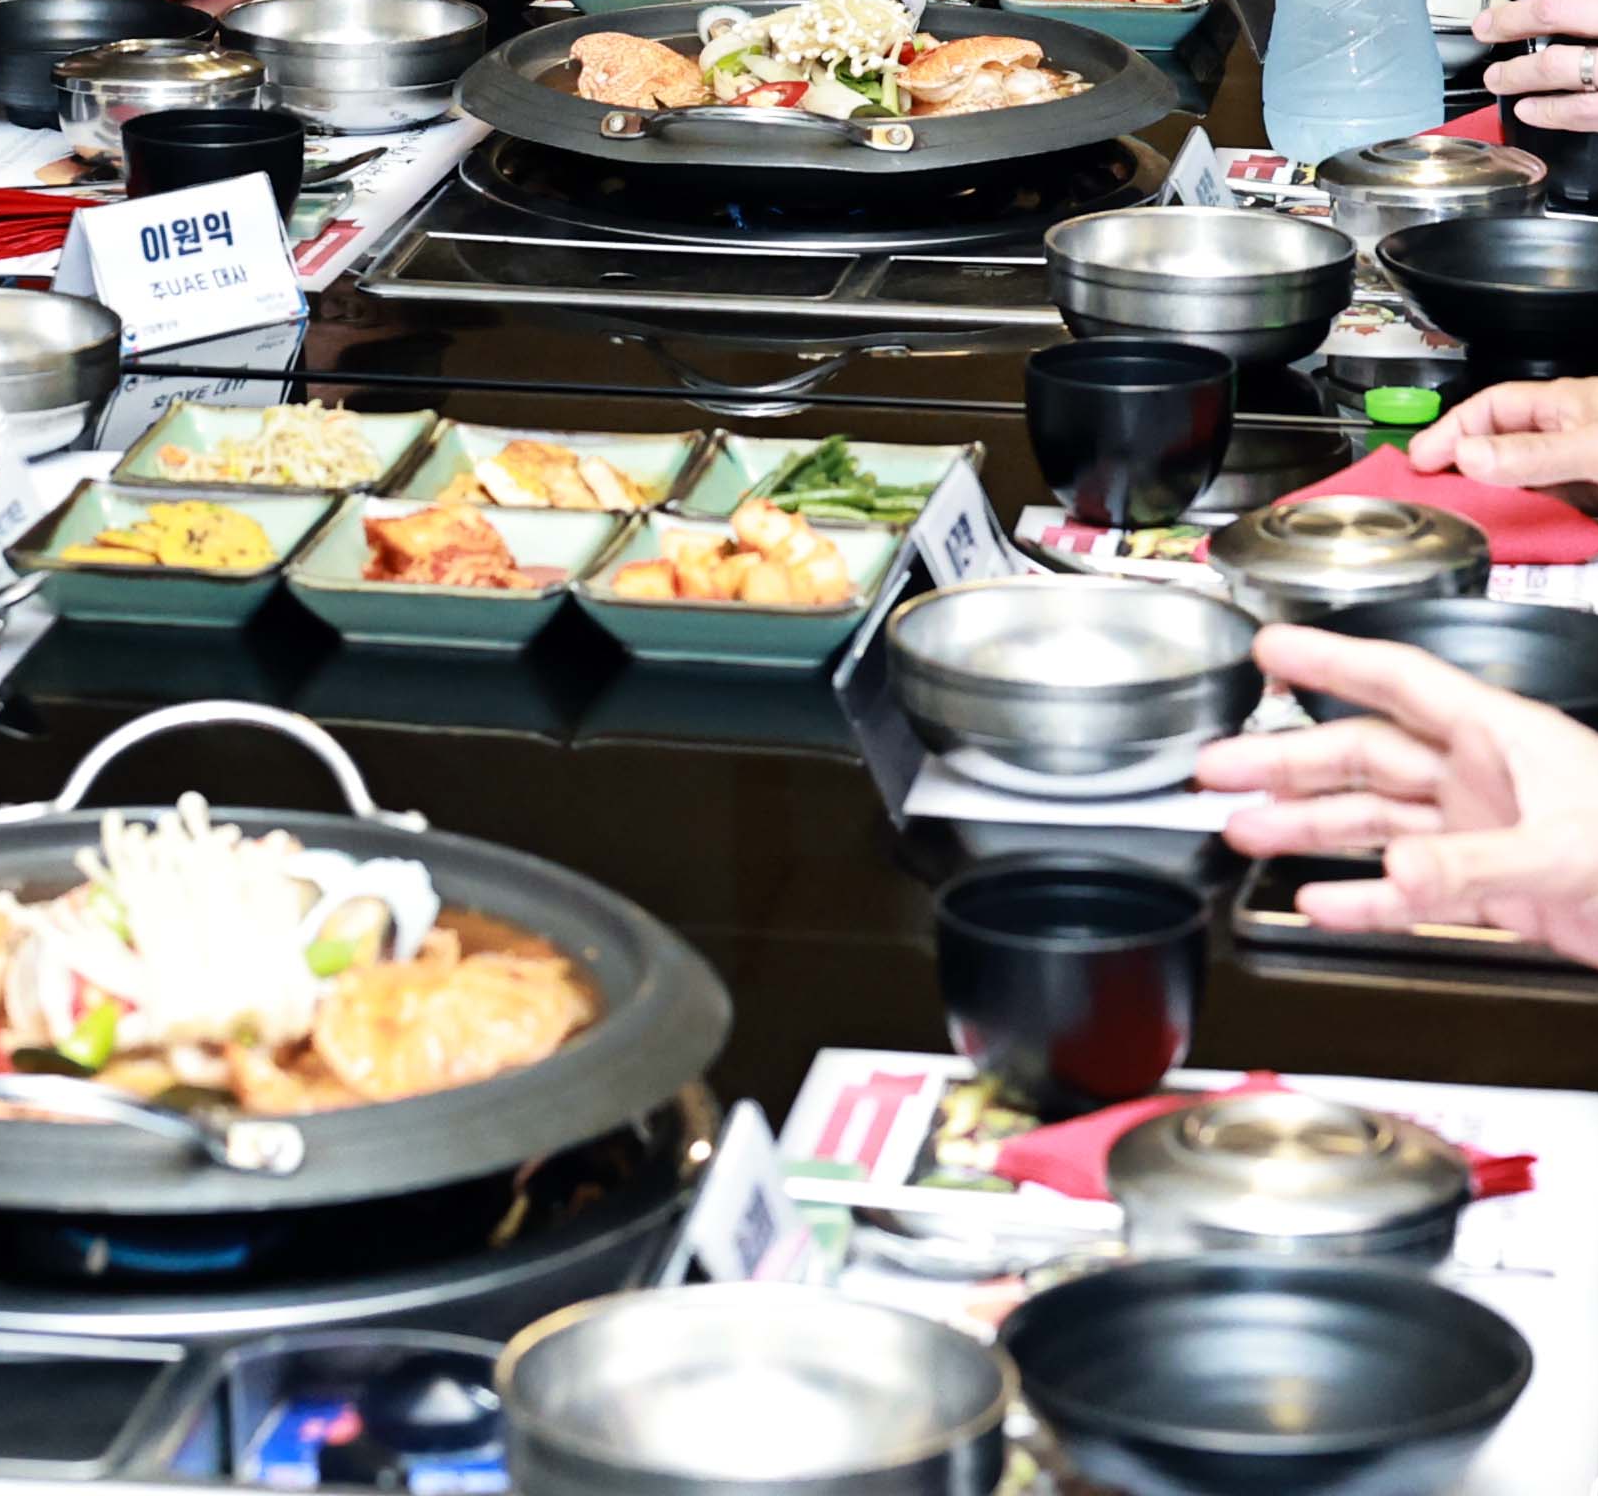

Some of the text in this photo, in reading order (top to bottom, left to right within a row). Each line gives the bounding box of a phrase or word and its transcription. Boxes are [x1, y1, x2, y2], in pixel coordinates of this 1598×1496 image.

[140, 210, 233, 263] 이원익
[149, 264, 249, 300] 주UAE 대사
